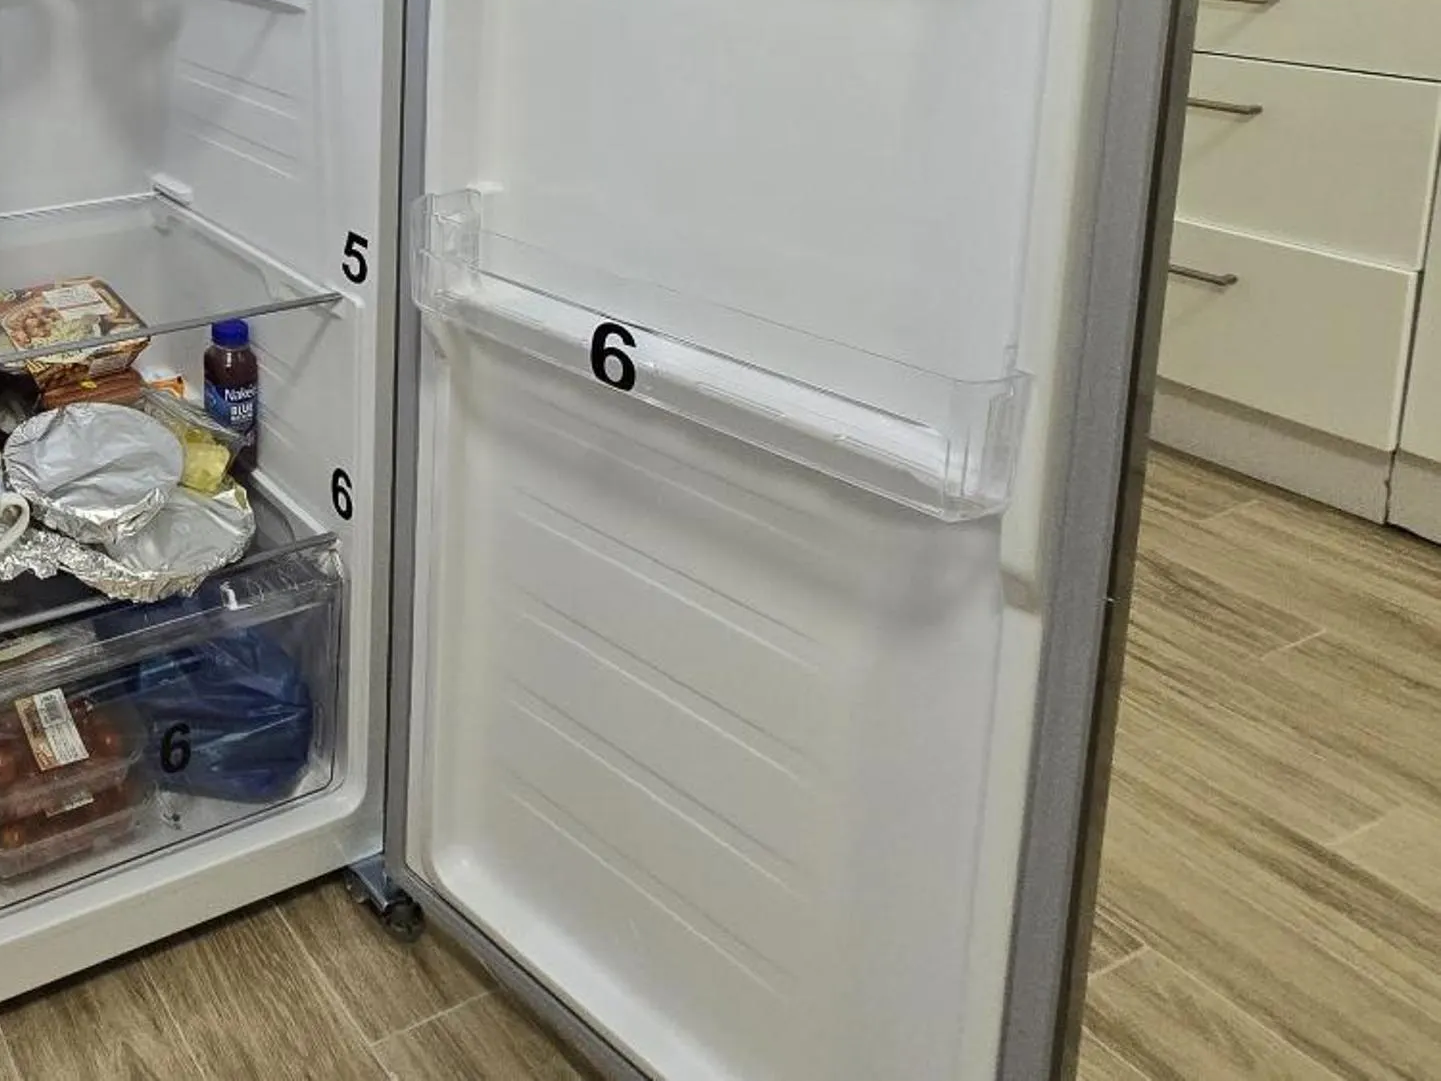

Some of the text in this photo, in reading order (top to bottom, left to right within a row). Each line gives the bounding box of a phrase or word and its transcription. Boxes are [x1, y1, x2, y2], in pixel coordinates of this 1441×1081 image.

[341, 231, 368, 284] 5
[590, 322, 637, 391] 6
[331, 468, 353, 521] 6
[159, 723, 192, 773] 6
